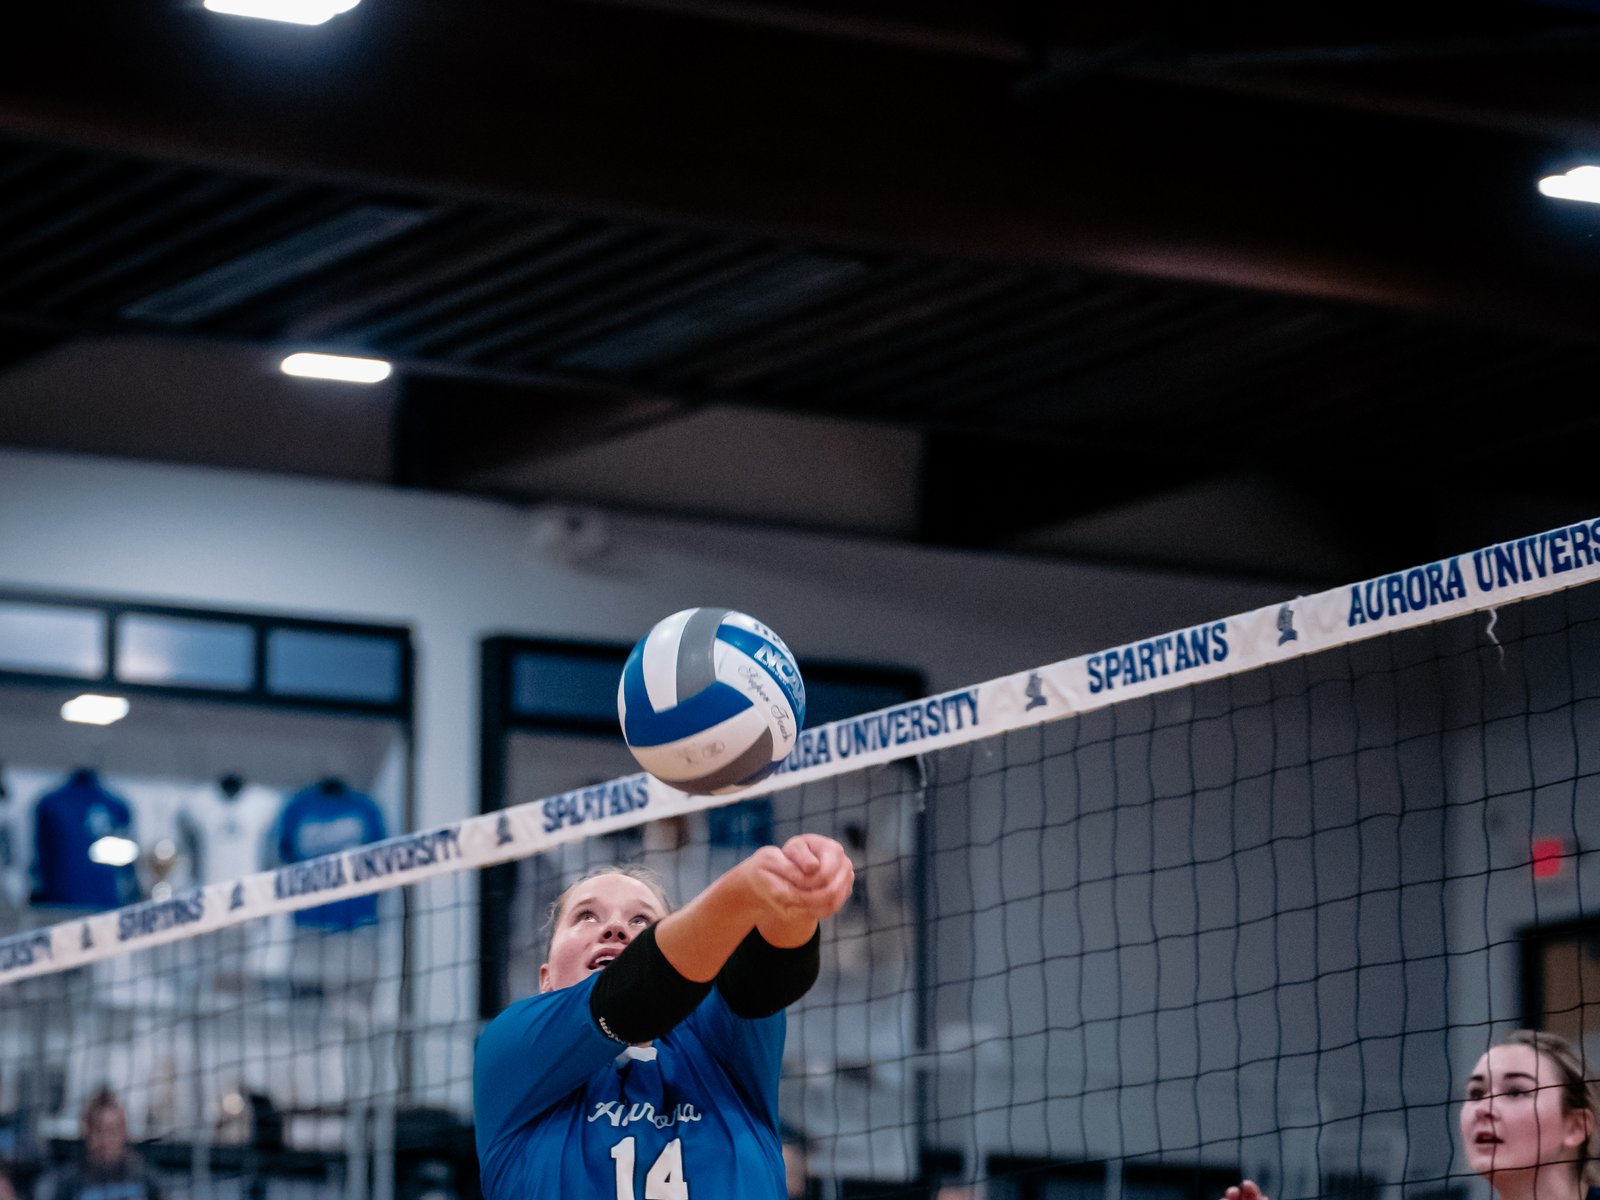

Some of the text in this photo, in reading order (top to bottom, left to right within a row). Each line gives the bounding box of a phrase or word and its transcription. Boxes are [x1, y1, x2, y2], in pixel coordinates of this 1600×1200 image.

[1347, 557, 1467, 628] AURORA
[1087, 622, 1229, 694] SPARTANS
[836, 689, 979, 759] UNIVERSITY
[542, 776, 649, 832] SPARTANS
